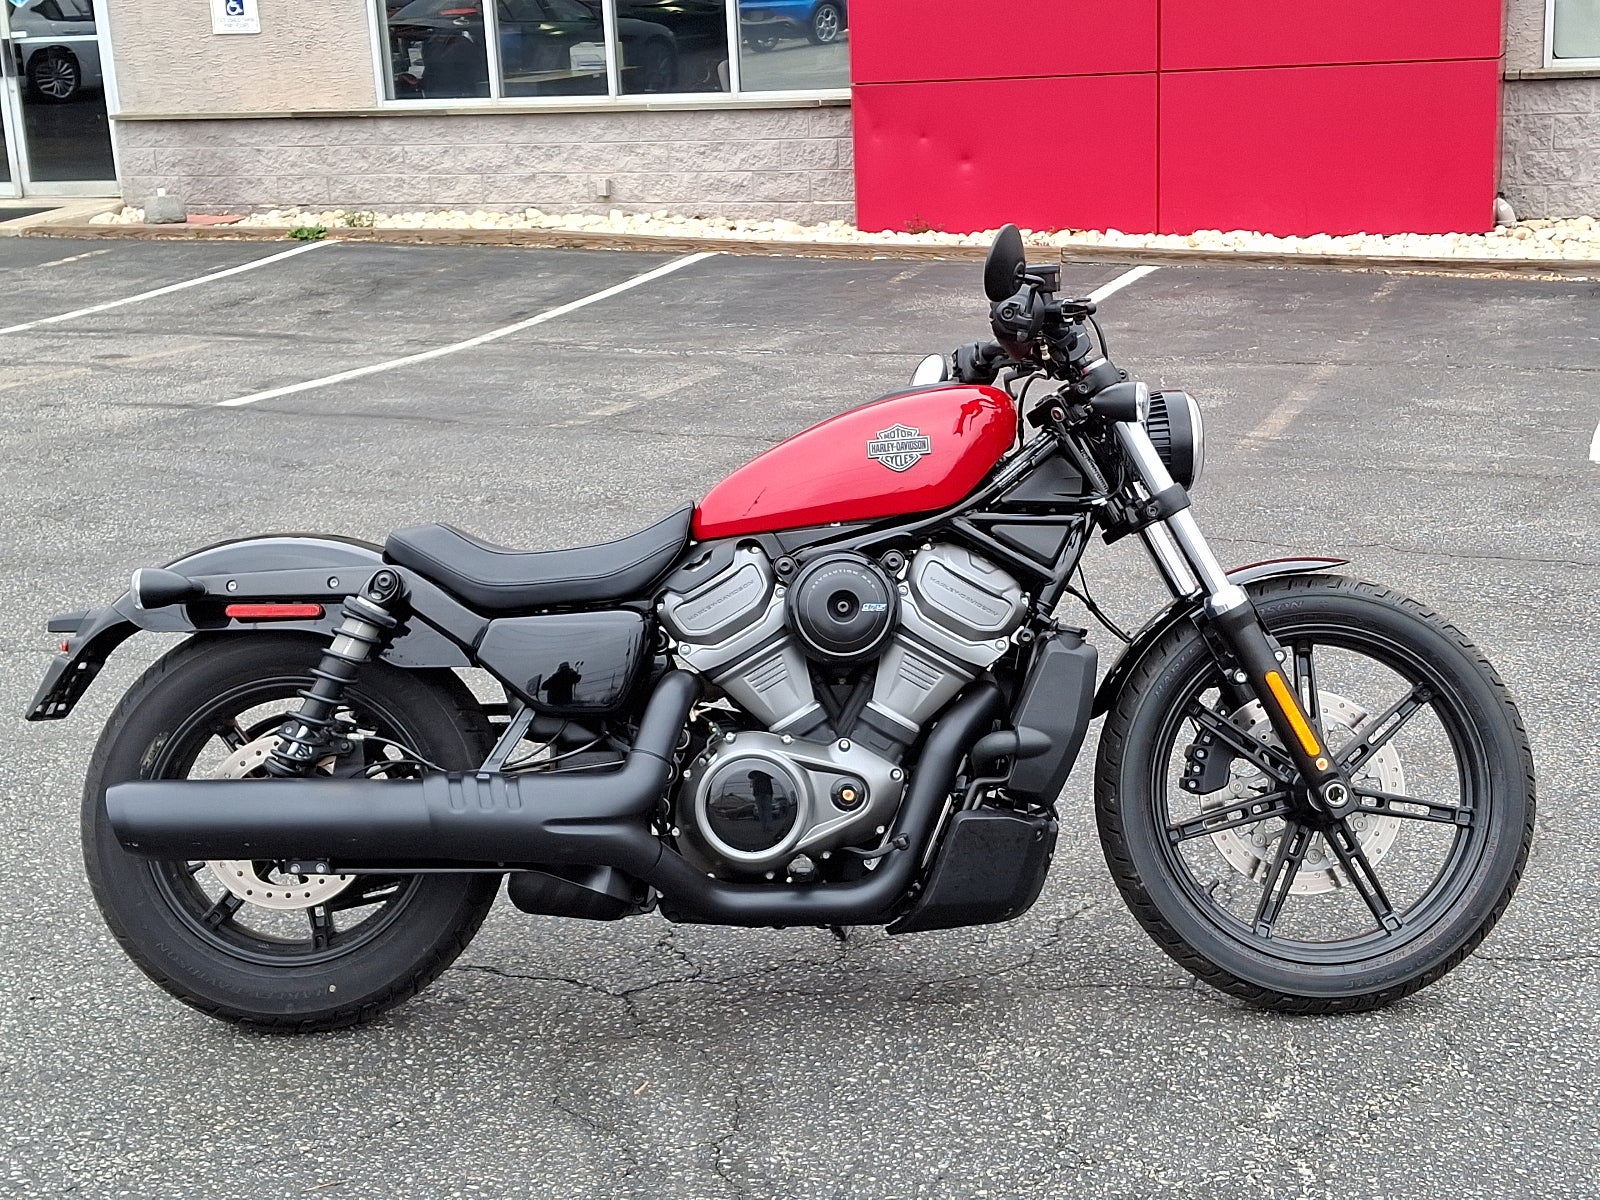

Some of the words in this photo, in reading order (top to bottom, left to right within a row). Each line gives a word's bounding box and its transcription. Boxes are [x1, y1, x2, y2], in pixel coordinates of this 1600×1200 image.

[883, 427, 913, 439] MOTOR
[871, 440, 926, 453] HARLEY-DAVIDSON
[884, 453, 914, 467] CYCLES
